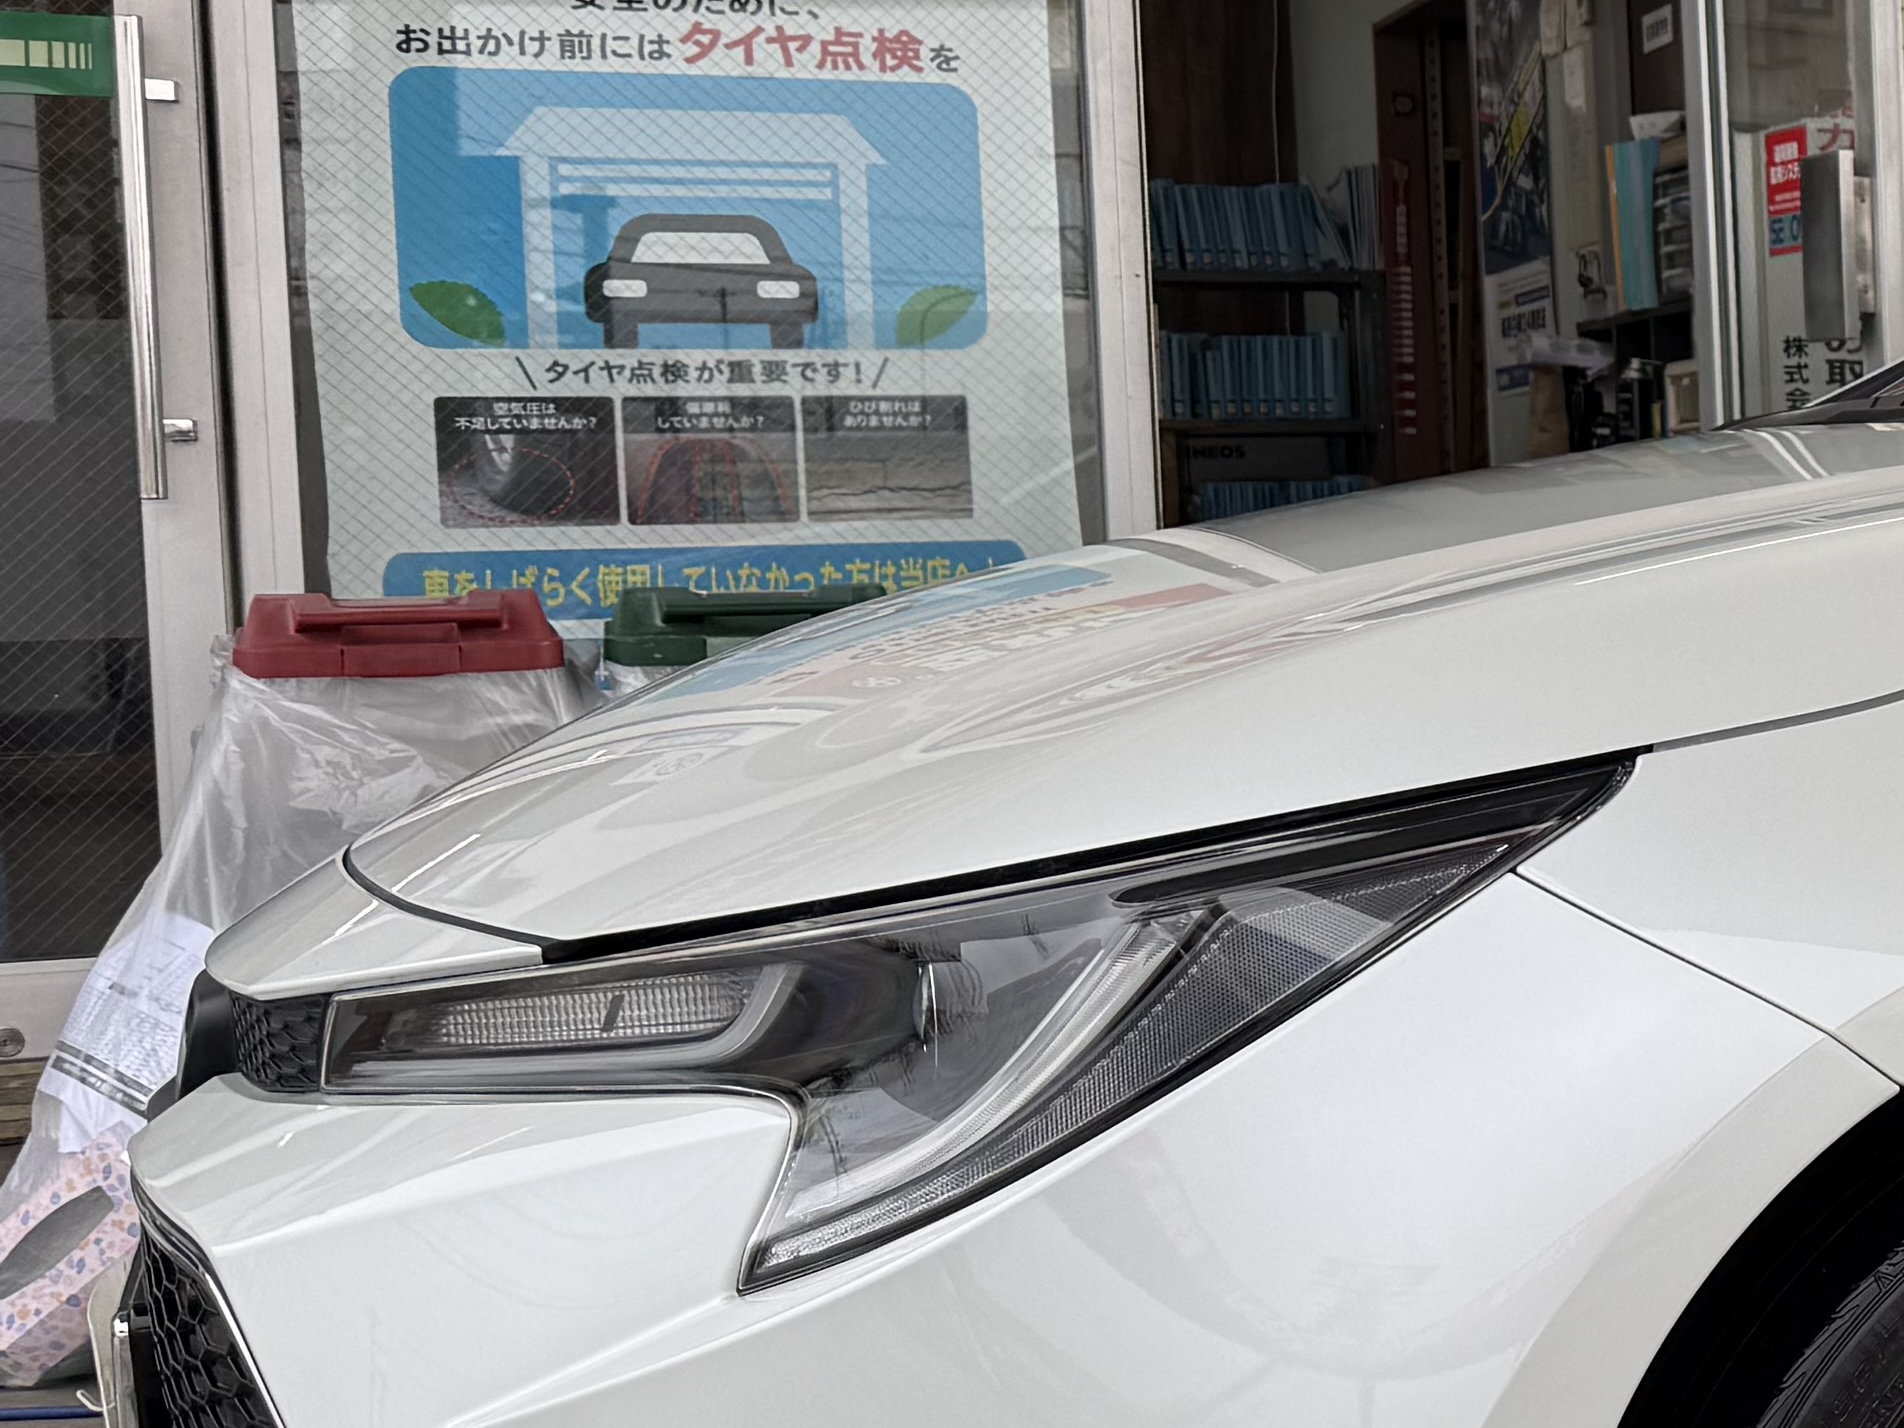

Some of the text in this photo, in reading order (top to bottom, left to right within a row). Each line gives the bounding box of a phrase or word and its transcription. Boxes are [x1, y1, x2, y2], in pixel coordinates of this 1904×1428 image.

[544, 358, 862, 387] タイヤ点検が重要です！
